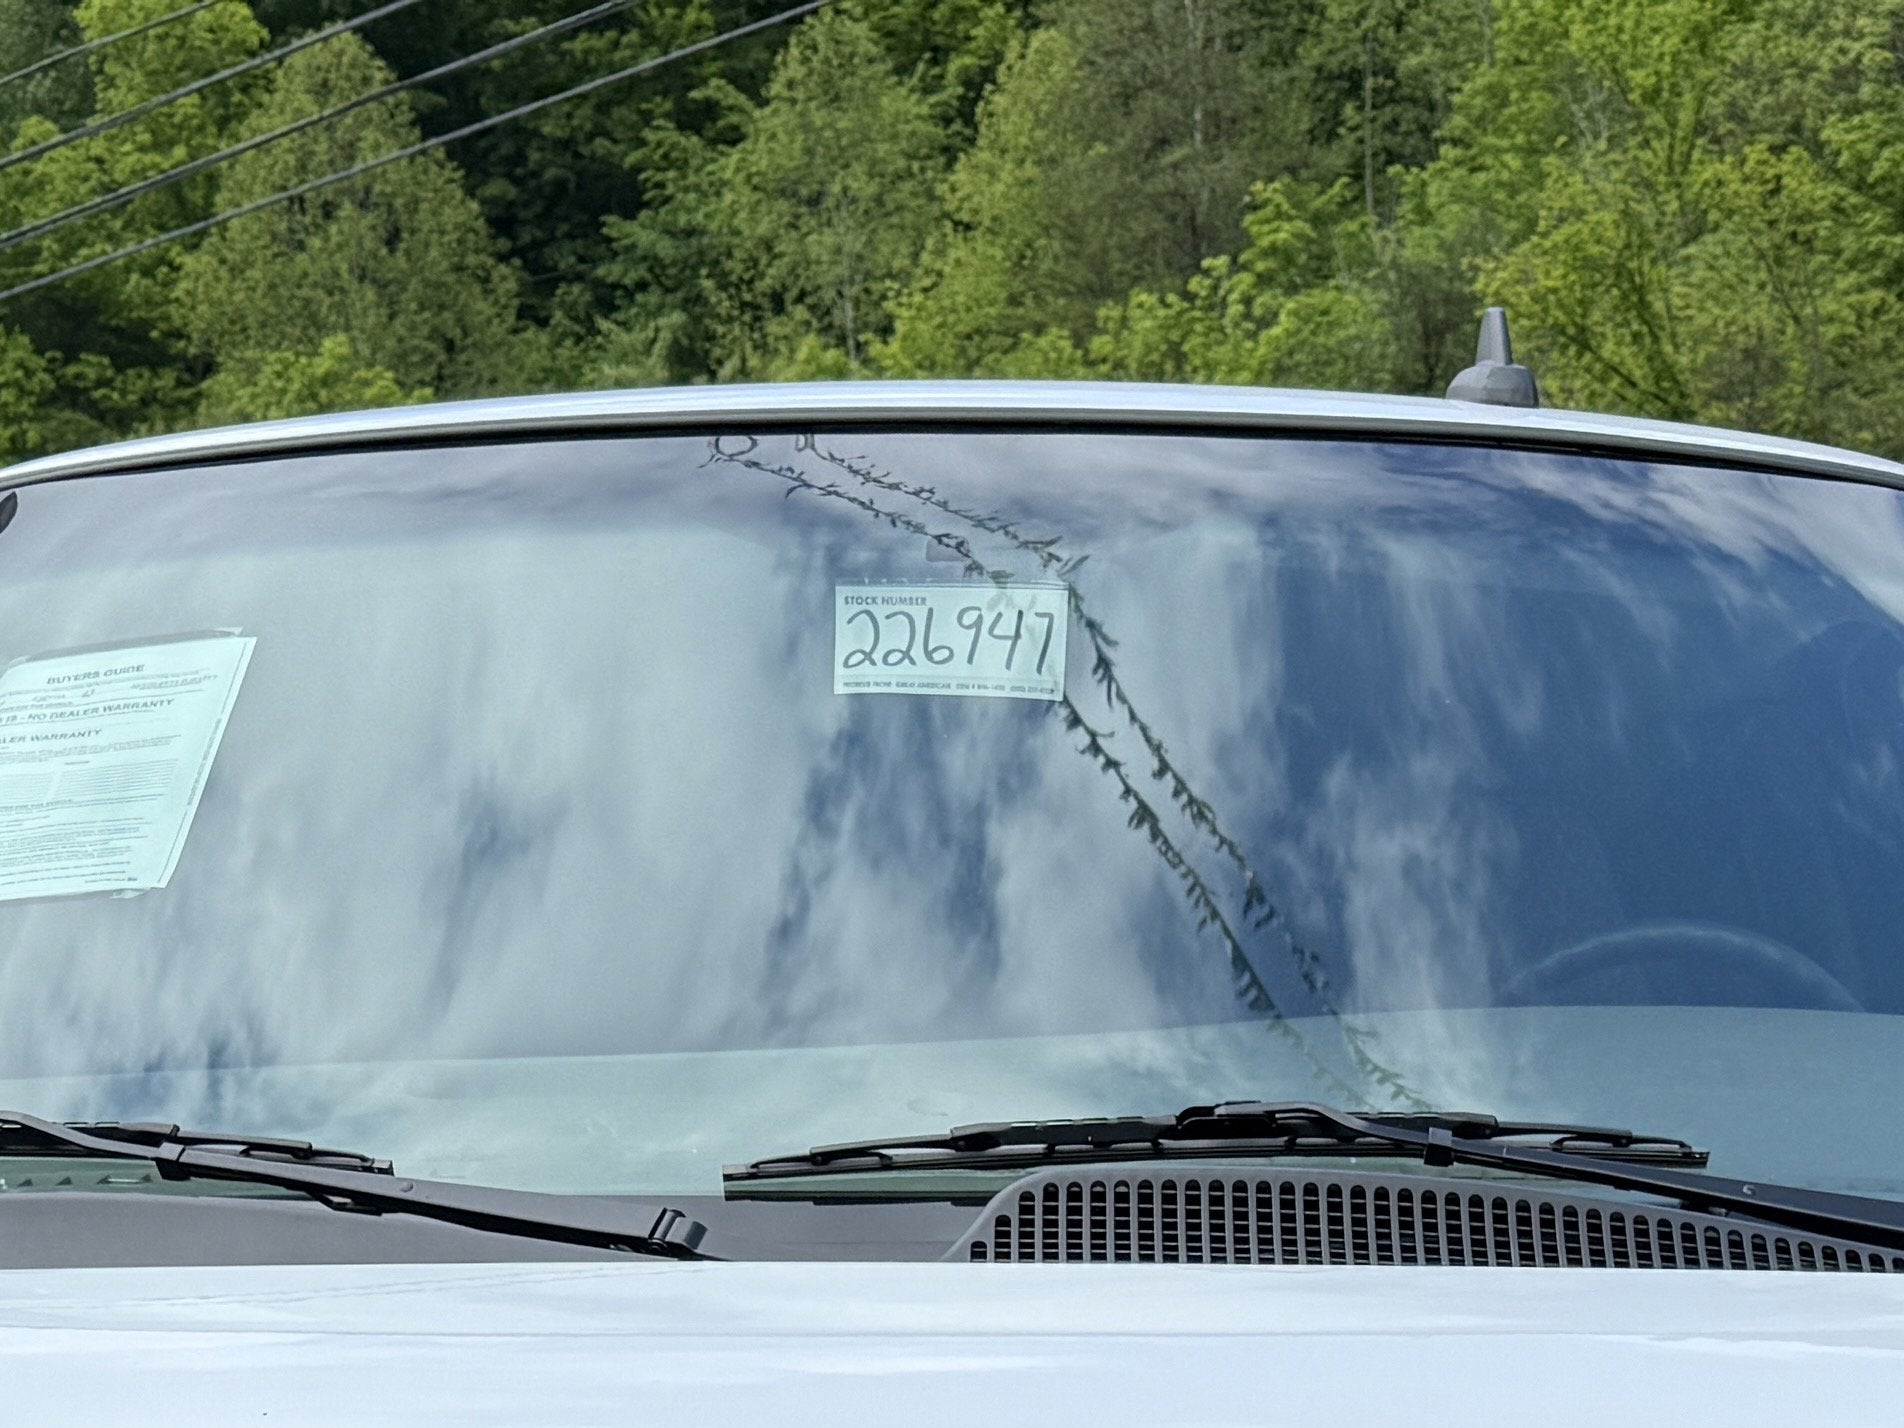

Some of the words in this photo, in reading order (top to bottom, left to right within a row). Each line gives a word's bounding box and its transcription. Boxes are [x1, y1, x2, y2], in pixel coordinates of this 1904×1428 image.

[844, 595, 878, 605] STOCK
[881, 596, 927, 606] NUMBER
[843, 606, 1054, 675] 226947
[47, 670, 100, 685] BUYERS
[103, 664, 145, 677] GUIDE
[50, 707, 100, 719] DEALER
[102, 699, 175, 714] WARRANTY
[30, 729, 103, 741] WARRANTY
